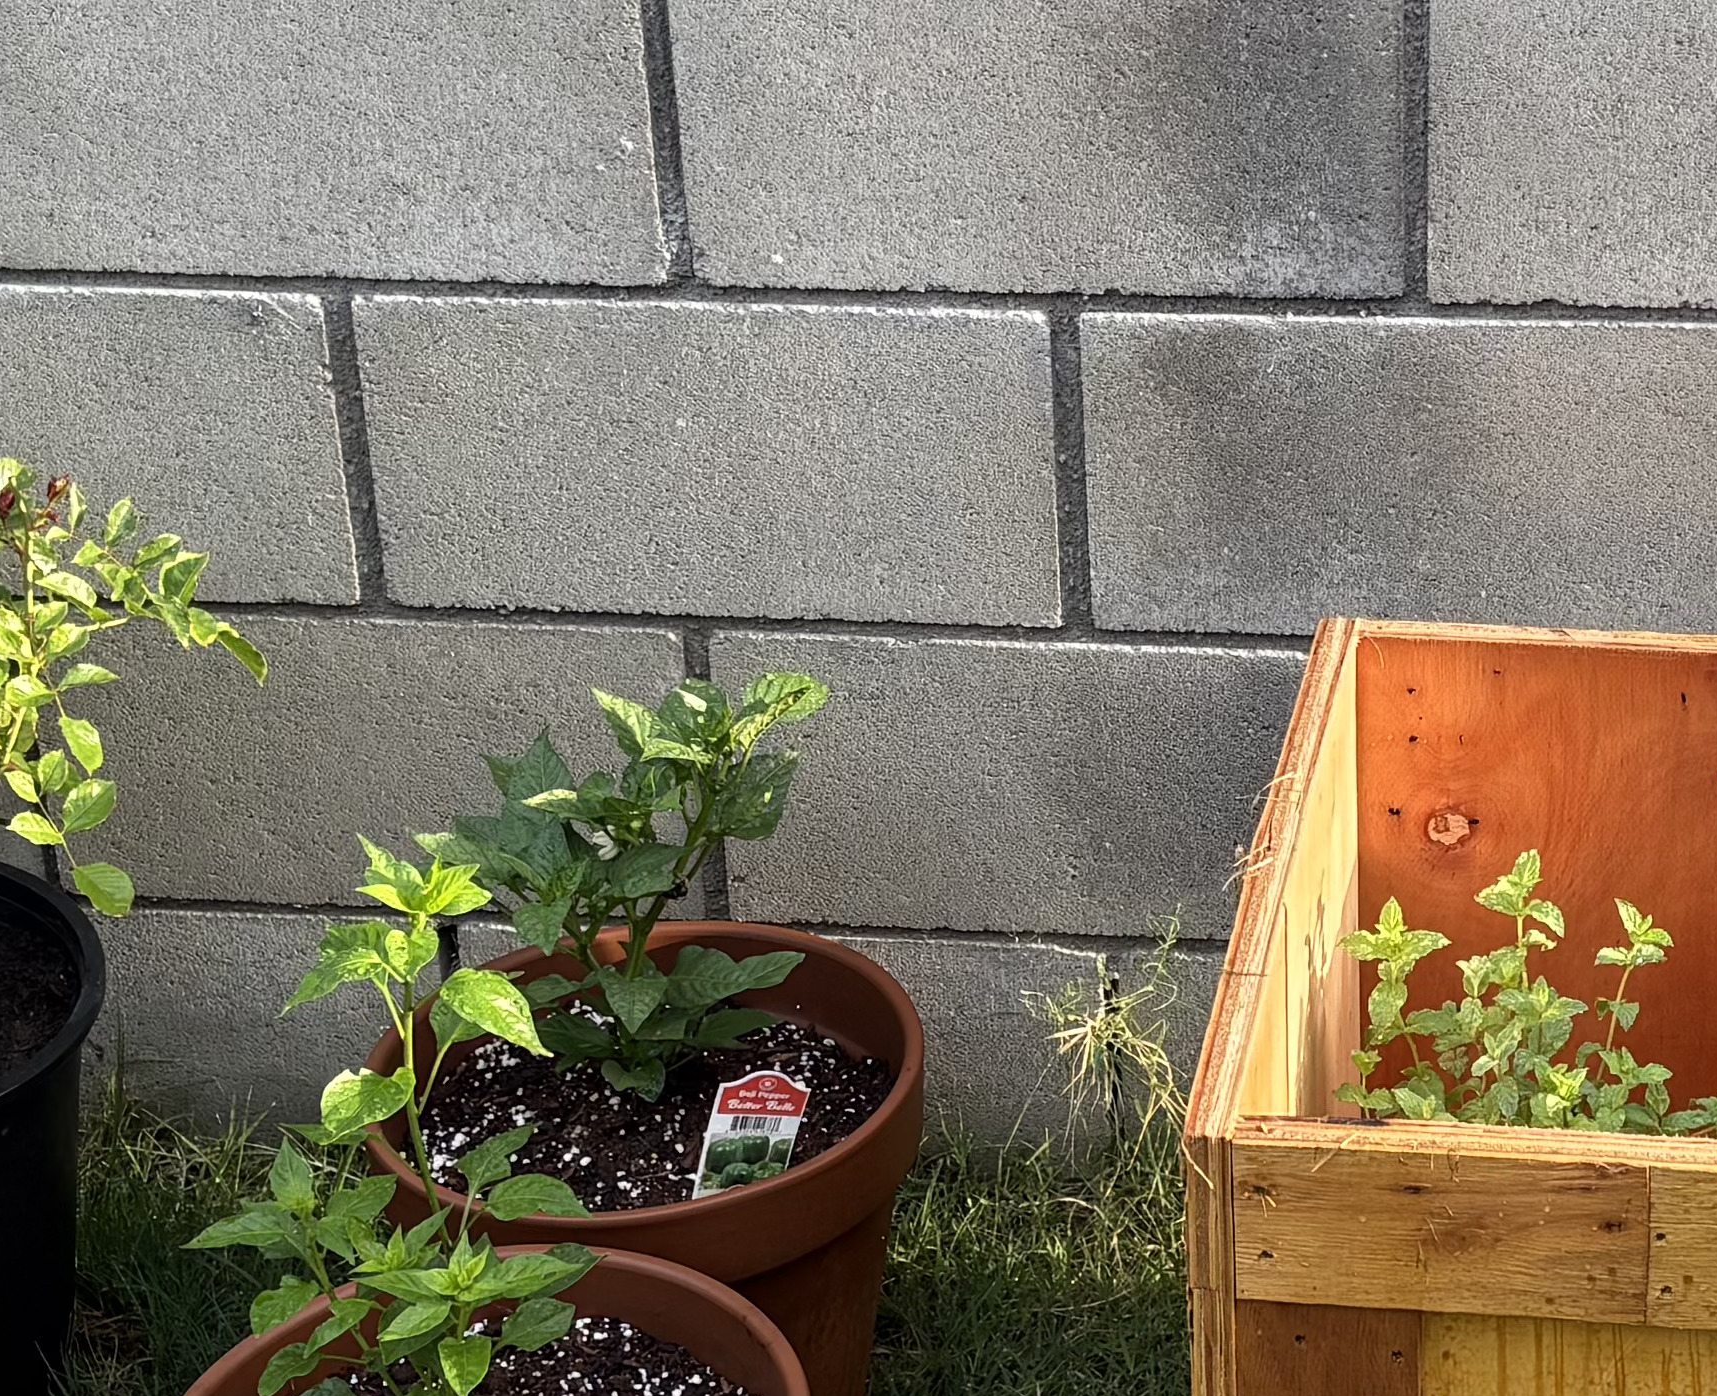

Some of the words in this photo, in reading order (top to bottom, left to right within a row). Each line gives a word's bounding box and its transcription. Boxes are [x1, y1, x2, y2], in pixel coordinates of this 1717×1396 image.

[738, 1089, 757, 1098] Bell
[758, 1091, 790, 1099] Pepper
[727, 1098, 764, 1109] Better
